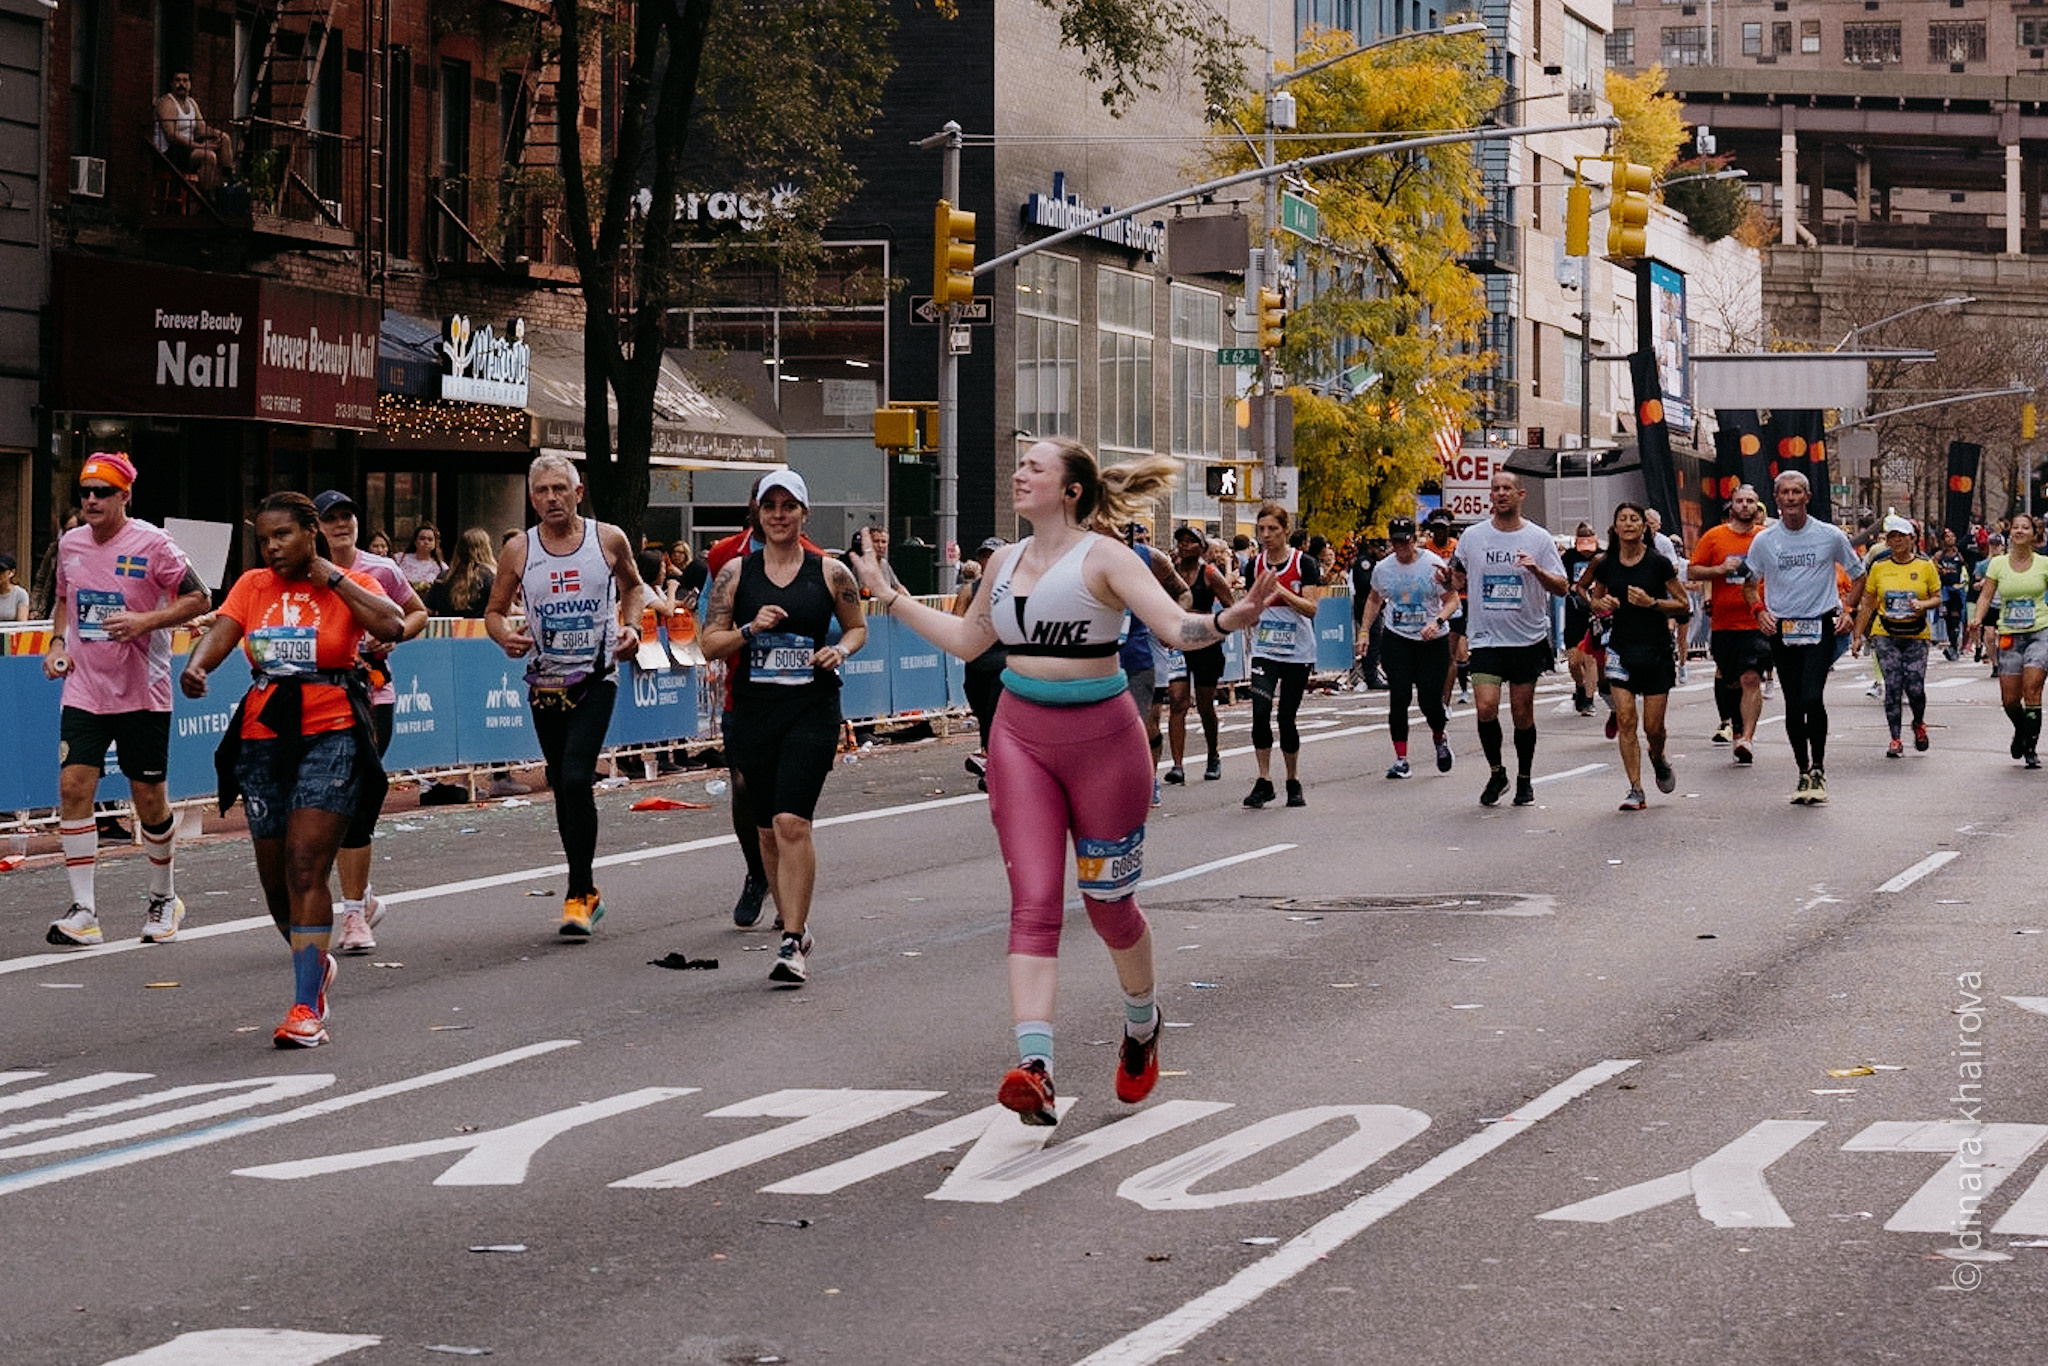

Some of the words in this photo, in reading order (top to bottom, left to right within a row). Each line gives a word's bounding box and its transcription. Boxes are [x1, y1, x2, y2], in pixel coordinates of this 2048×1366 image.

[1125, 213, 1165, 264] storage
[155, 308, 199, 330] Forever
[200, 310, 243, 335] Beauty
[262, 319, 308, 371] Forever
[308, 326, 350, 387] Beauty
[351, 332, 376, 380] Nail
[1222, 351, 1229, 363] E
[1232, 350, 1245, 363] 62
[156, 340, 240, 388] Nail
[1447, 494, 1496, 515] -265-
[533, 599, 601, 618] NORWAY
[562, 632, 590, 648] 58184
[1030, 620, 1092, 645] NIKE
[274, 641, 311, 661] 59799
[178, 712, 230, 737] UNITED
[396, 721, 409, 734] RUN
[409, 720, 421, 733] FOR
[422, 719, 435, 732] LIFE
[486, 716, 498, 728] RUN
[499, 715, 511, 727] FOR
[511, 715, 524, 727] LIFE
